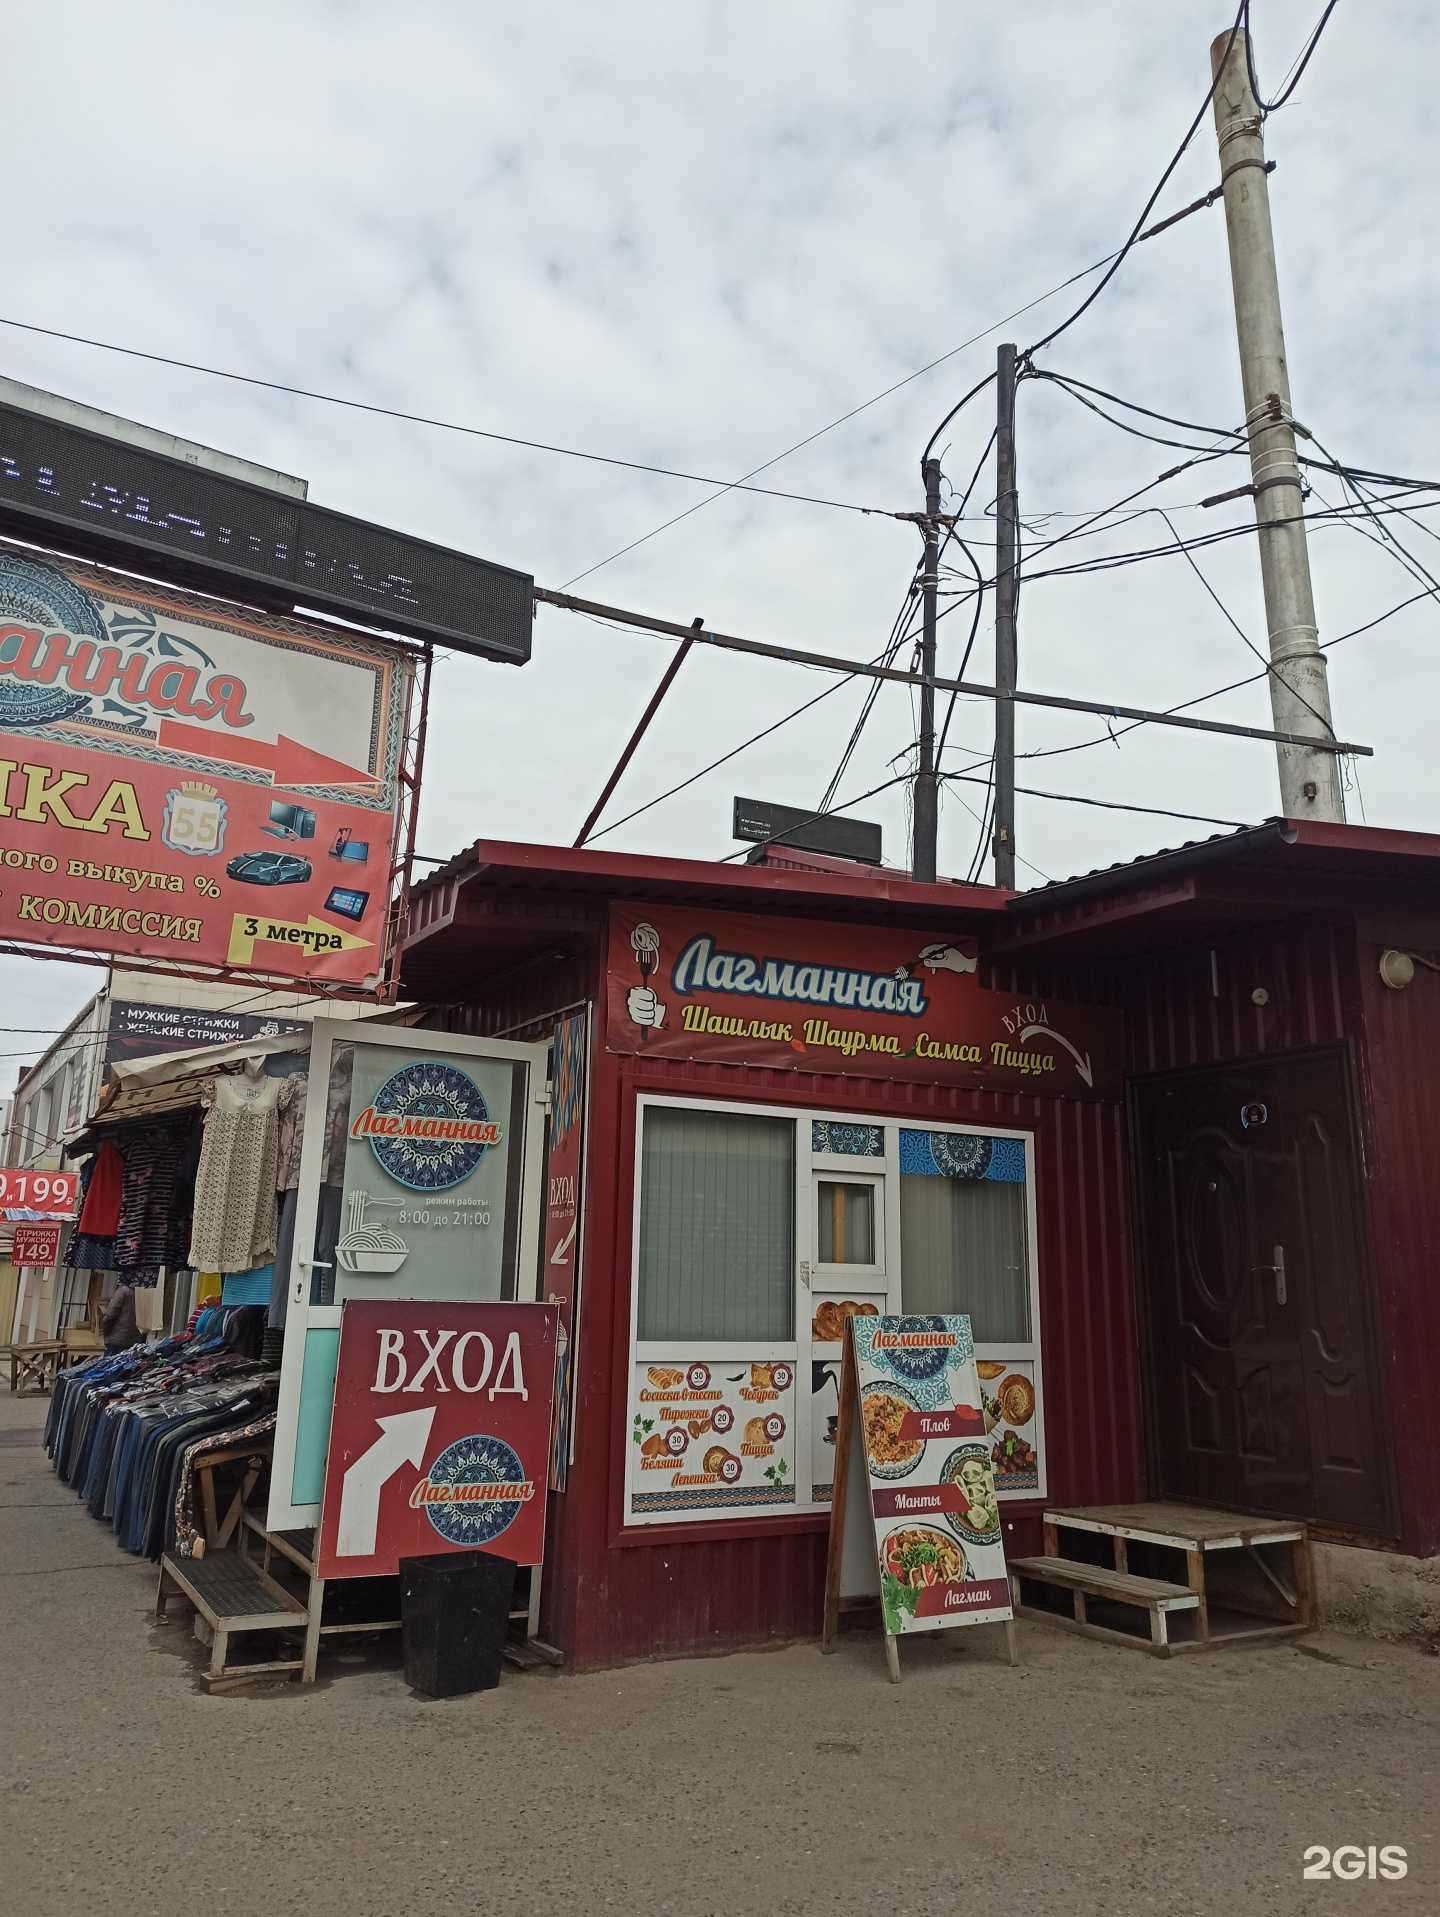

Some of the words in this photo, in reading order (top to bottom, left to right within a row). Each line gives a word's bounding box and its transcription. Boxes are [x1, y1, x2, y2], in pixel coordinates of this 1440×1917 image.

[173, 808, 217, 843] 55
[67, 859, 184, 893] выкупа
[193, 875, 222, 898] %
[17, 894, 204, 942] КОМИССИЯ
[244, 918, 259, 936] 3
[266, 925, 343, 952] метра
[675, 938, 925, 1014] Лагманная
[127, 1009, 180, 1023] МУЖКИЕ
[182, 1014, 240, 1029] СТРИЖКИ
[1001, 1003, 1049, 1034] ВХОД
[682, 1004, 793, 1042] Шашлык
[803, 1019, 901, 1056] Шаурма
[915, 1032, 983, 1063] Самса
[991, 1042, 1056, 1075] Пицца
[351, 1106, 500, 1142] Лагманная
[550, 1176, 575, 1206] ВХОД
[457, 1198, 489, 1208] работы
[399, 1211, 430, 1224] 8:00
[433, 1216, 448, 1226] до
[452, 1212, 491, 1225] 21:00
[16, 1229, 57, 1237] СТРИЖКА
[16, 1236, 56, 1244] МУЖСКАЯ
[872, 1328, 959, 1350] Лагманная
[370, 1329, 529, 1402] ВХОД
[694, 1372, 704, 1380] 30
[777, 1372, 786, 1380] 30
[640, 1388, 680, 1402] Сосиска
[689, 1390, 723, 1401] тесте
[739, 1388, 779, 1404] Чебурек
[659, 1407, 710, 1424] Пирожки
[717, 1414, 727, 1422] 20
[770, 1422, 779, 1430] 50
[920, 1418, 952, 1434] Плов
[672, 1436, 682, 1444] 30
[740, 1443, 774, 1459] Пицца
[641, 1457, 684, 1470] Беляши
[725, 1463, 735, 1472] 30
[671, 1472, 716, 1488] Лепешка
[411, 1481, 535, 1505] Лагманная
[895, 1494, 943, 1510] Манты
[944, 1590, 992, 1607] Лагман
